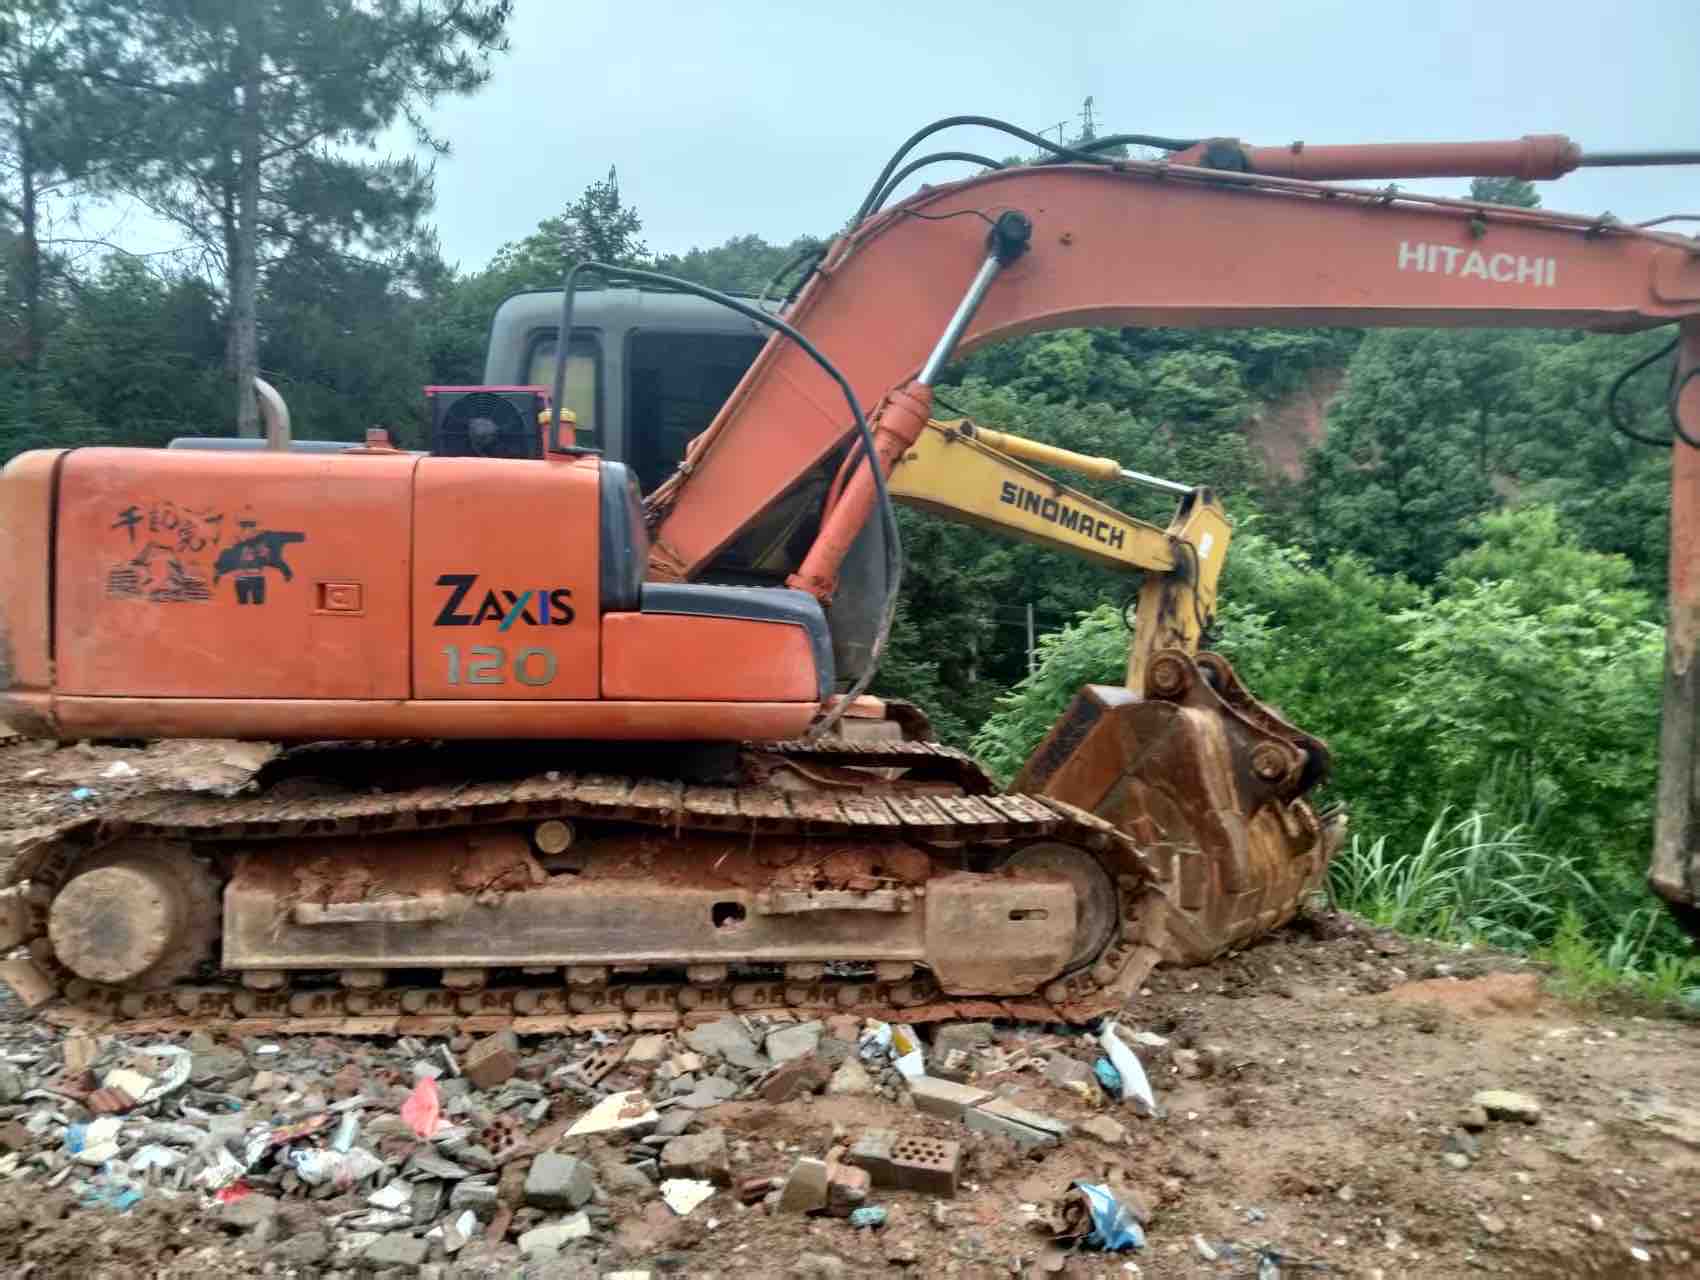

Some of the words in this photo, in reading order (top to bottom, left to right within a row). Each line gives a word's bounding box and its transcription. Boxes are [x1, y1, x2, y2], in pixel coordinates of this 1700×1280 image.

[1397, 240, 1557, 288] HITACHI
[1000, 480, 1125, 549] SINOMACH
[433, 573, 577, 632] ZAXIS
[439, 643, 558, 687] 120
